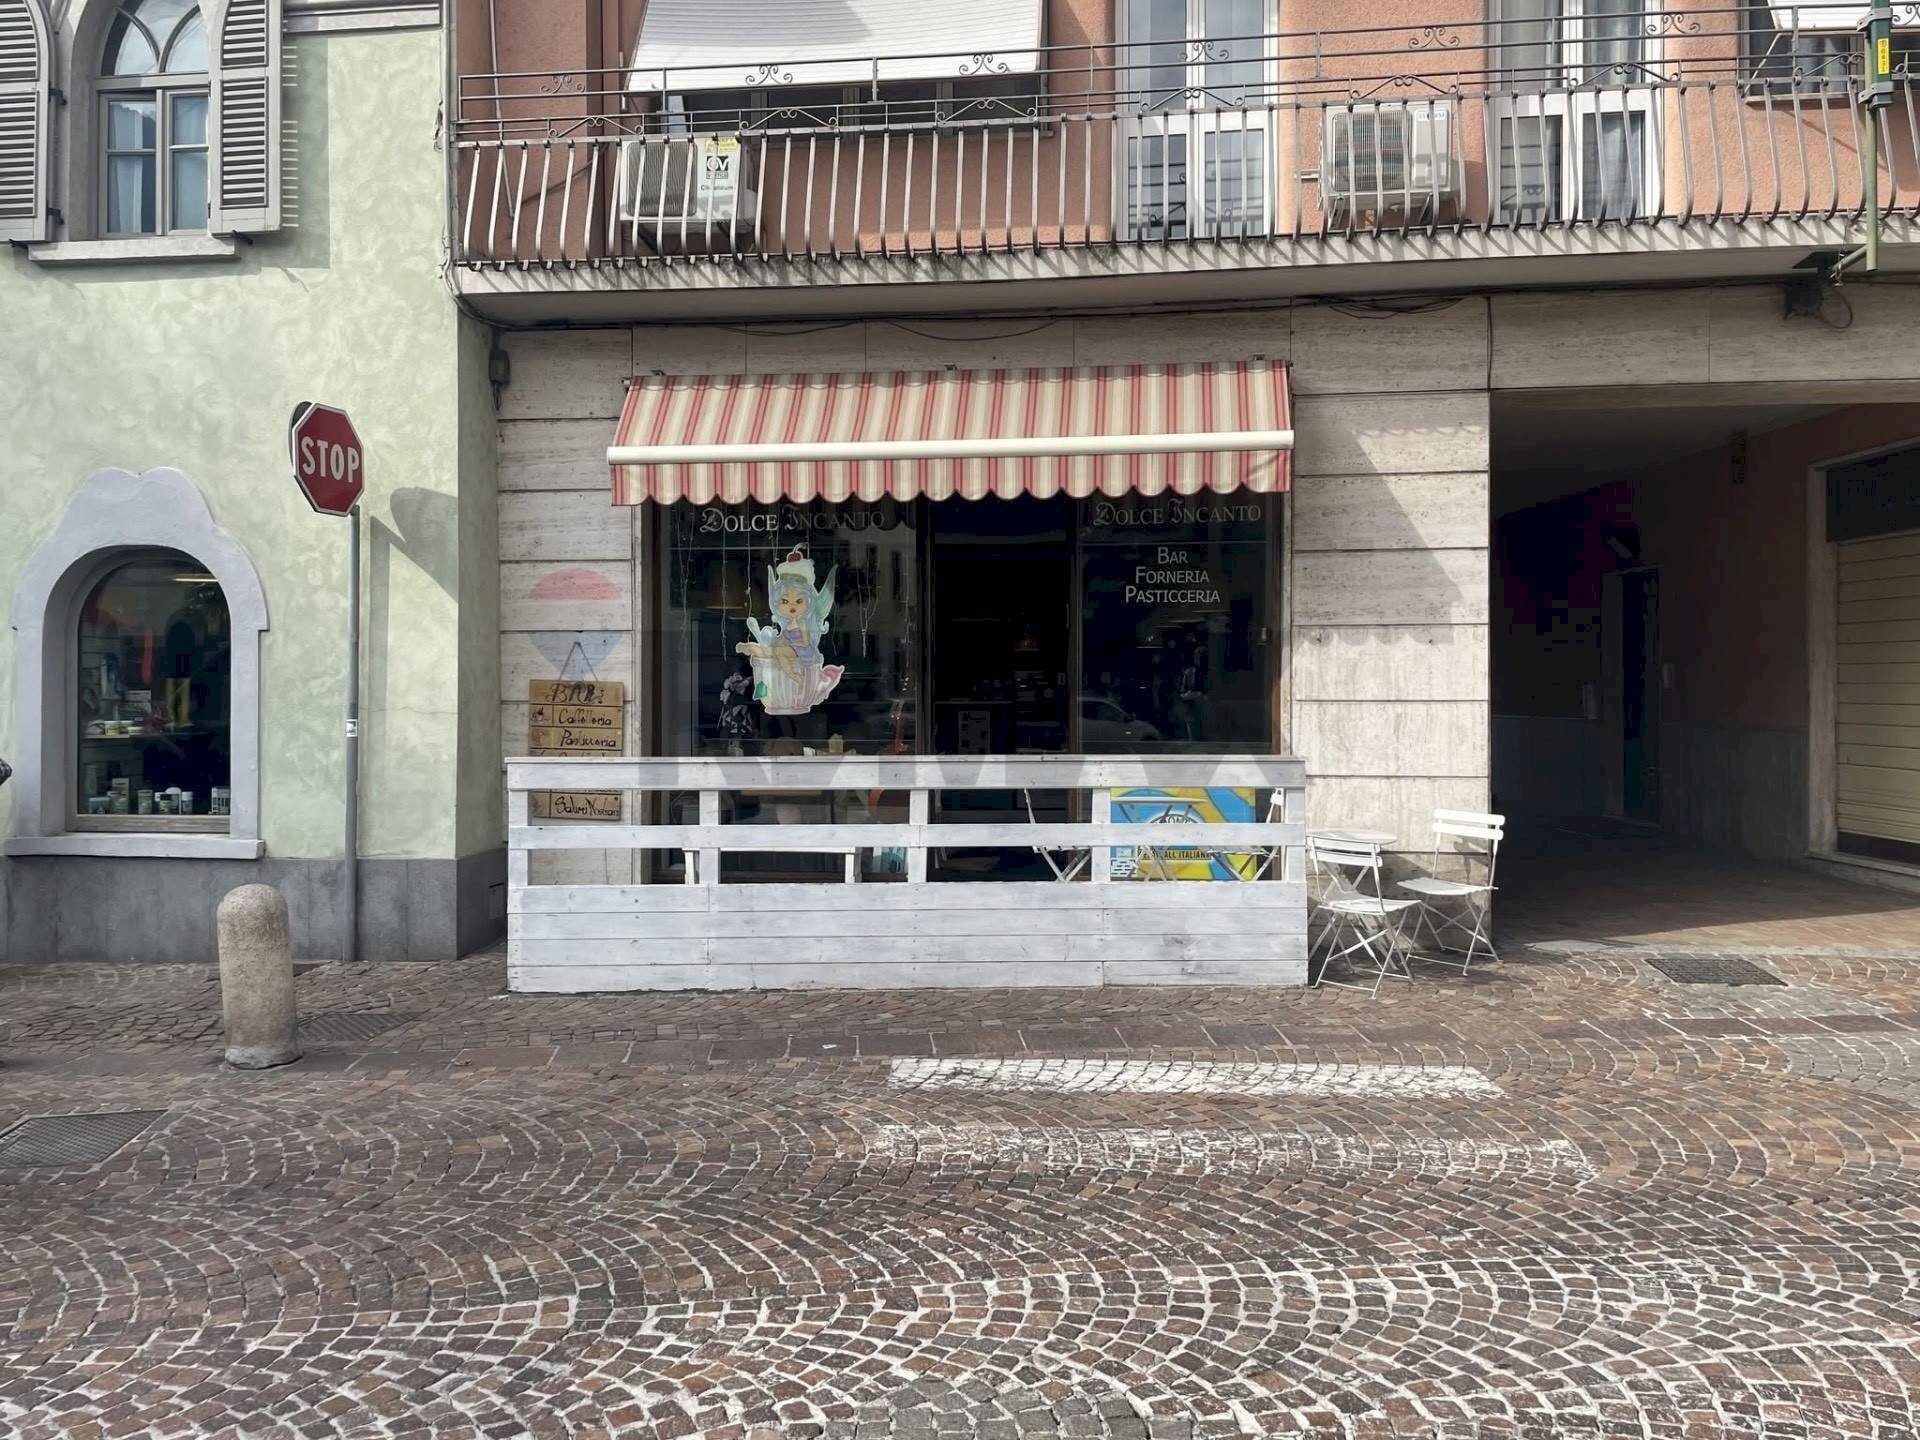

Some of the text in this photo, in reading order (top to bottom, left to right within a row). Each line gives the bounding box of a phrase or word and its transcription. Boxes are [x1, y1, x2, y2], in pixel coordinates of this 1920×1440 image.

[301, 436, 360, 483] STOP
[699, 507, 779, 533] DOLCE
[1092, 498, 1262, 526] DOLCE INCANTO
[1157, 546, 1189, 564] BAR
[1135, 566, 1211, 584] FORNERIA
[1125, 585, 1221, 603] PASTICCERIA
